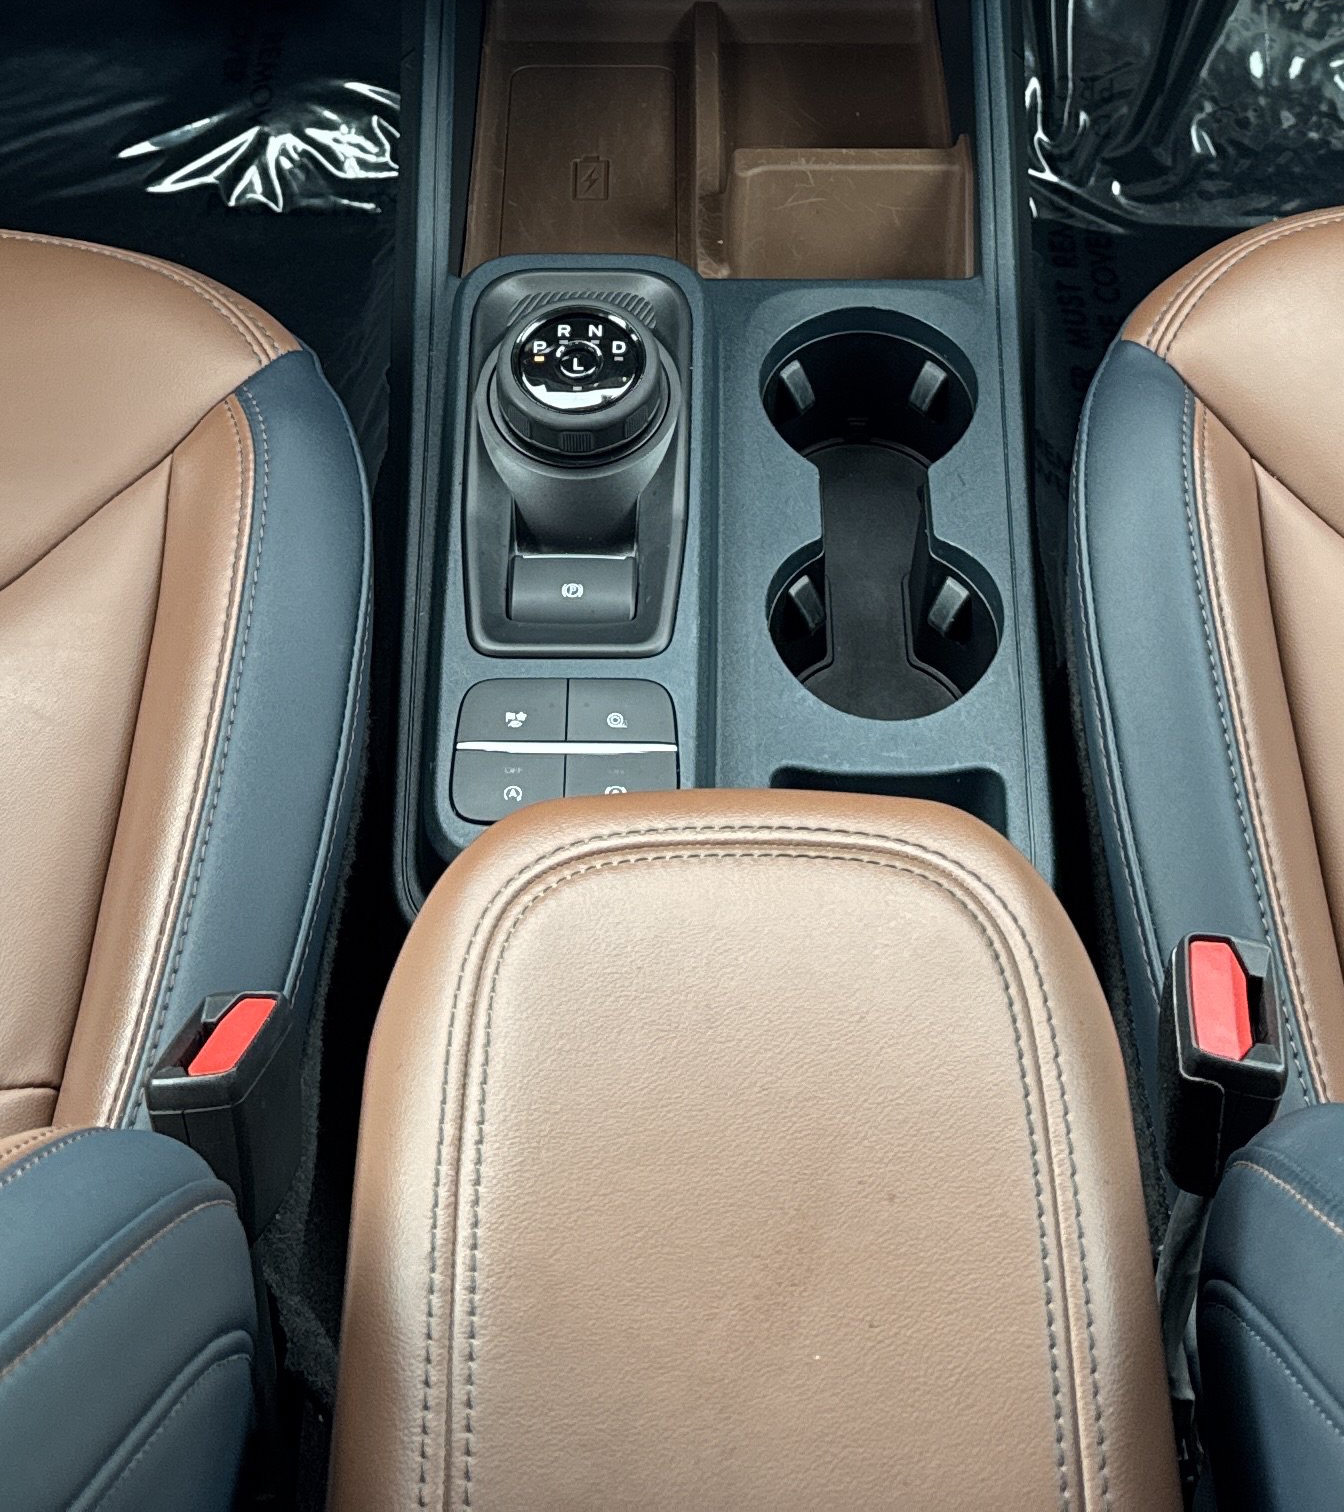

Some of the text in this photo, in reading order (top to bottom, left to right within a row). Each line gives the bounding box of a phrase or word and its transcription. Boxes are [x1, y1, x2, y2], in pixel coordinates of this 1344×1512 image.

[557, 324, 603, 337] R N
[533, 340, 626, 354] P D
[573, 357, 584, 370] L
